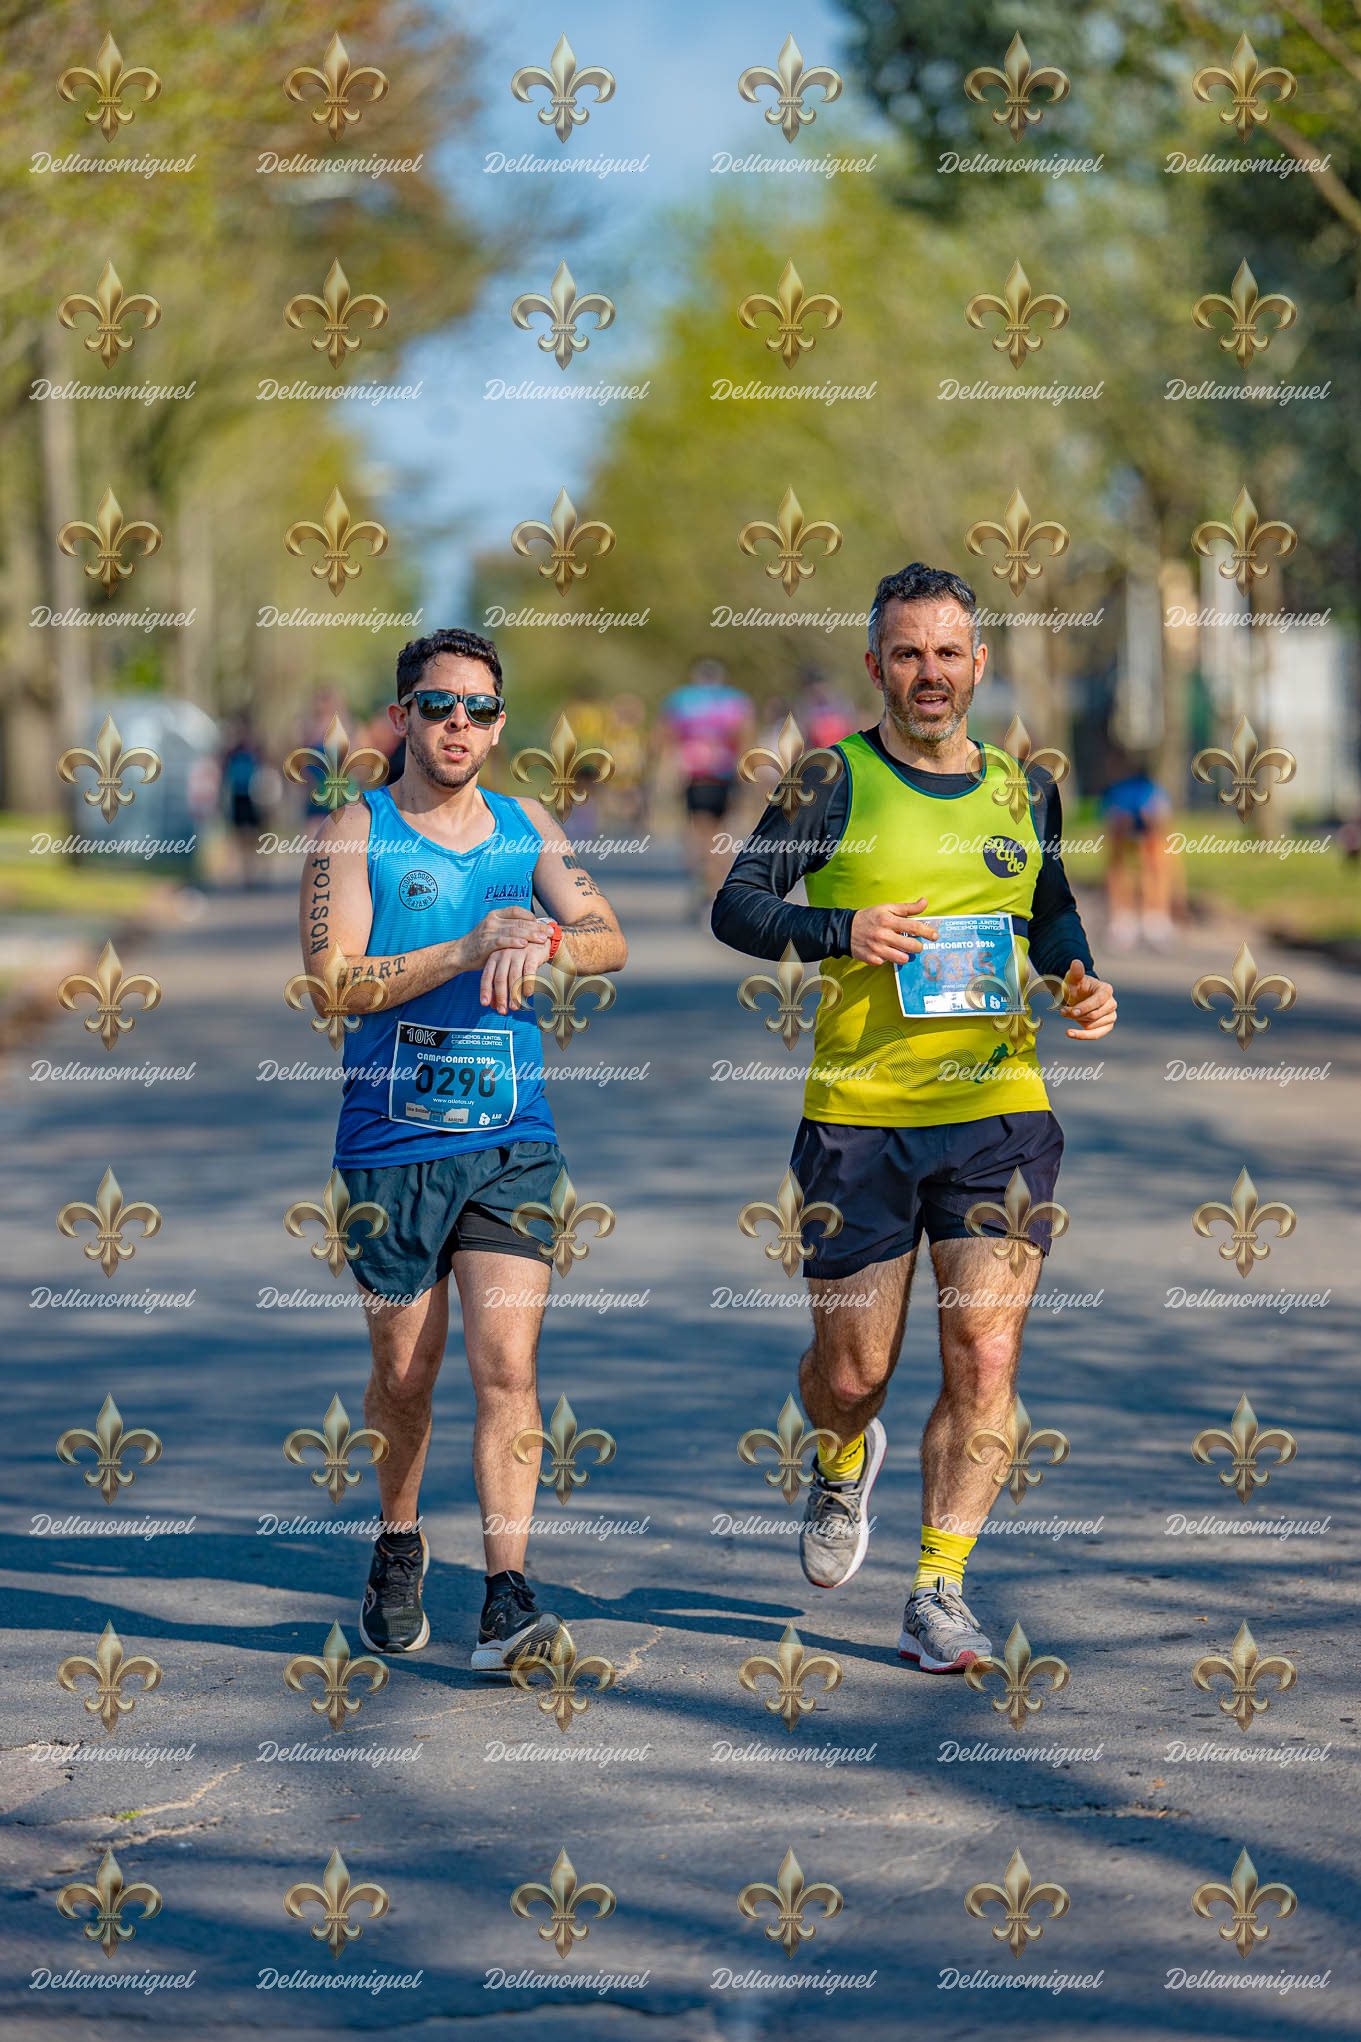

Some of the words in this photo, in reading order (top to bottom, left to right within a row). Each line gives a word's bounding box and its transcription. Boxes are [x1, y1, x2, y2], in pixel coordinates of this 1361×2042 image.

[1007, 858, 1024, 873] de
[309, 857, 330, 956] POISON
[922, 941, 974, 950] AMPEONATO
[975, 940, 996, 949] 2026
[337, 956, 406, 990] HEART
[923, 951, 996, 983] 0315
[407, 1027, 437, 1046] 10K
[416, 1052, 475, 1064] CAMPEONATO
[476, 1055, 496, 1065] 2026
[415, 1064, 496, 1098] 0290
